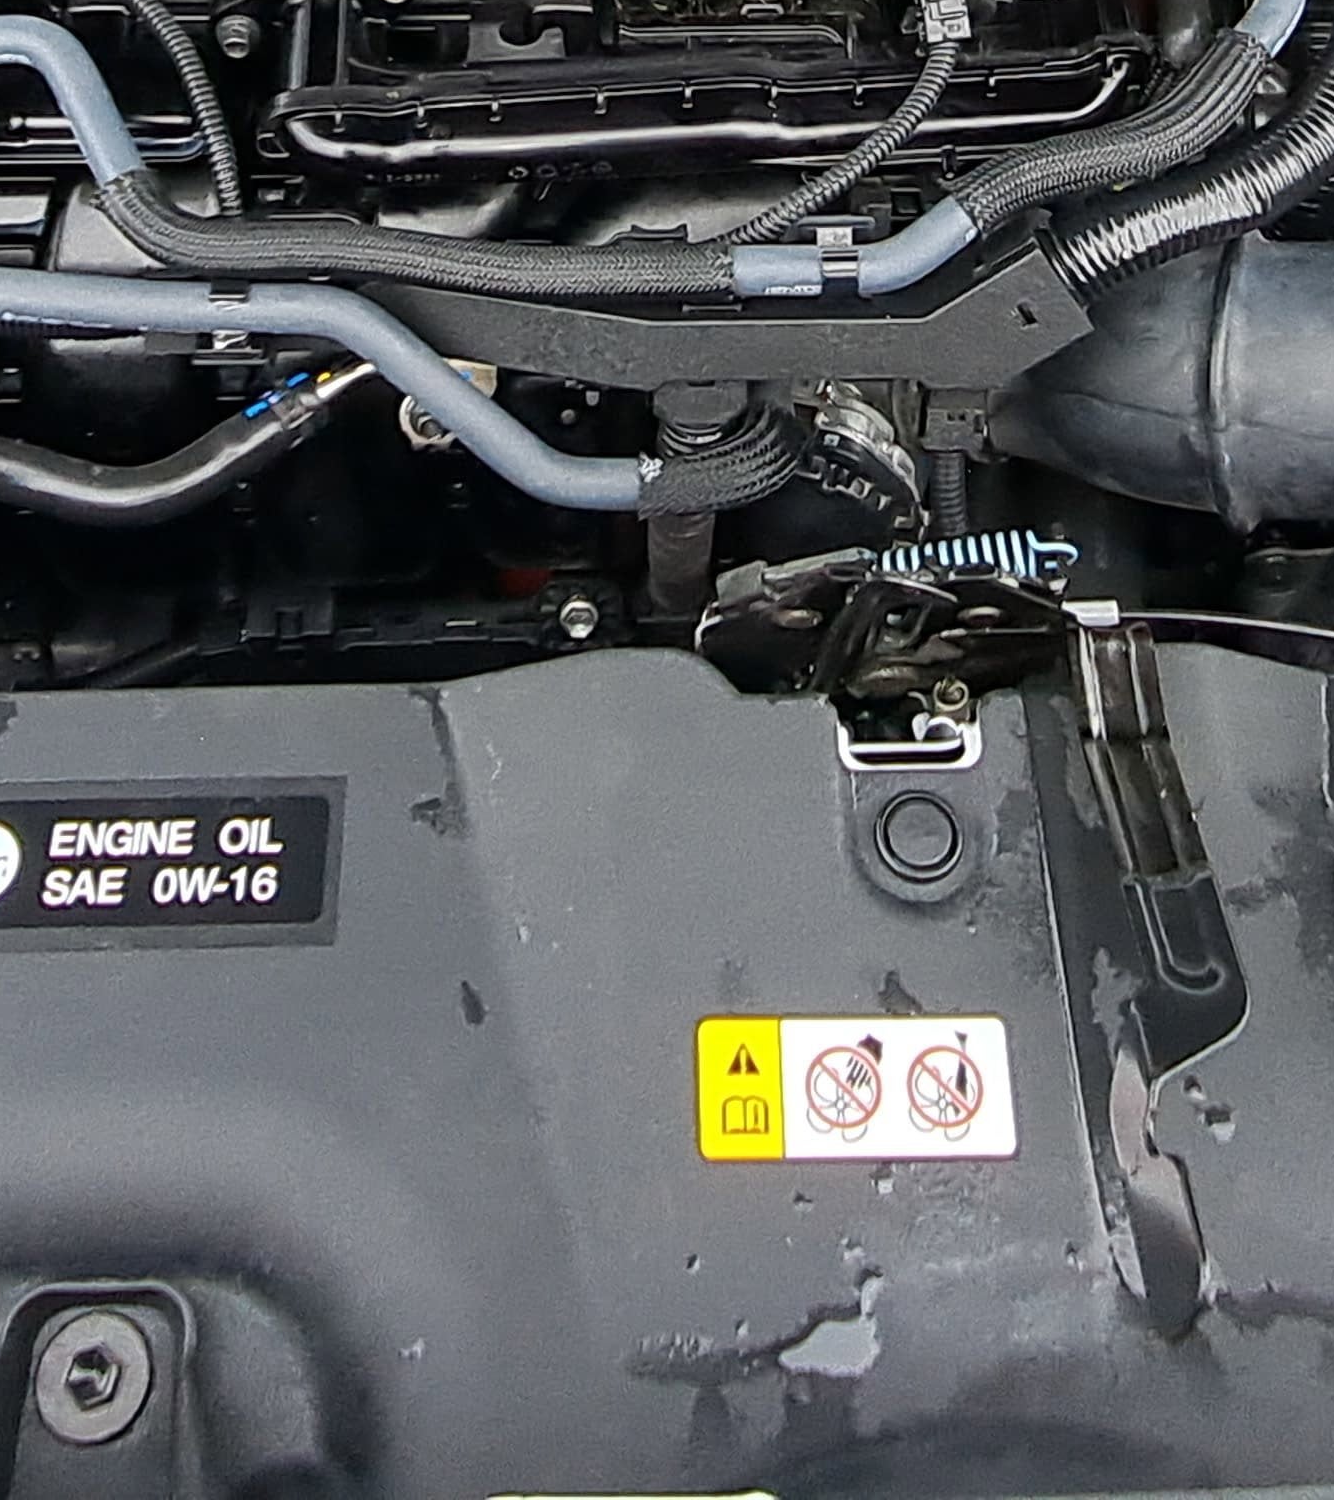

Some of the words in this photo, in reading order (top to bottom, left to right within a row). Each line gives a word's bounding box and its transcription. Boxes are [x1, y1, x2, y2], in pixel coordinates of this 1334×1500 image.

[48, 818, 196, 858] ENGINE
[217, 817, 284, 855] OIL
[42, 866, 128, 906] SAE
[151, 865, 279, 905] 0W-16
